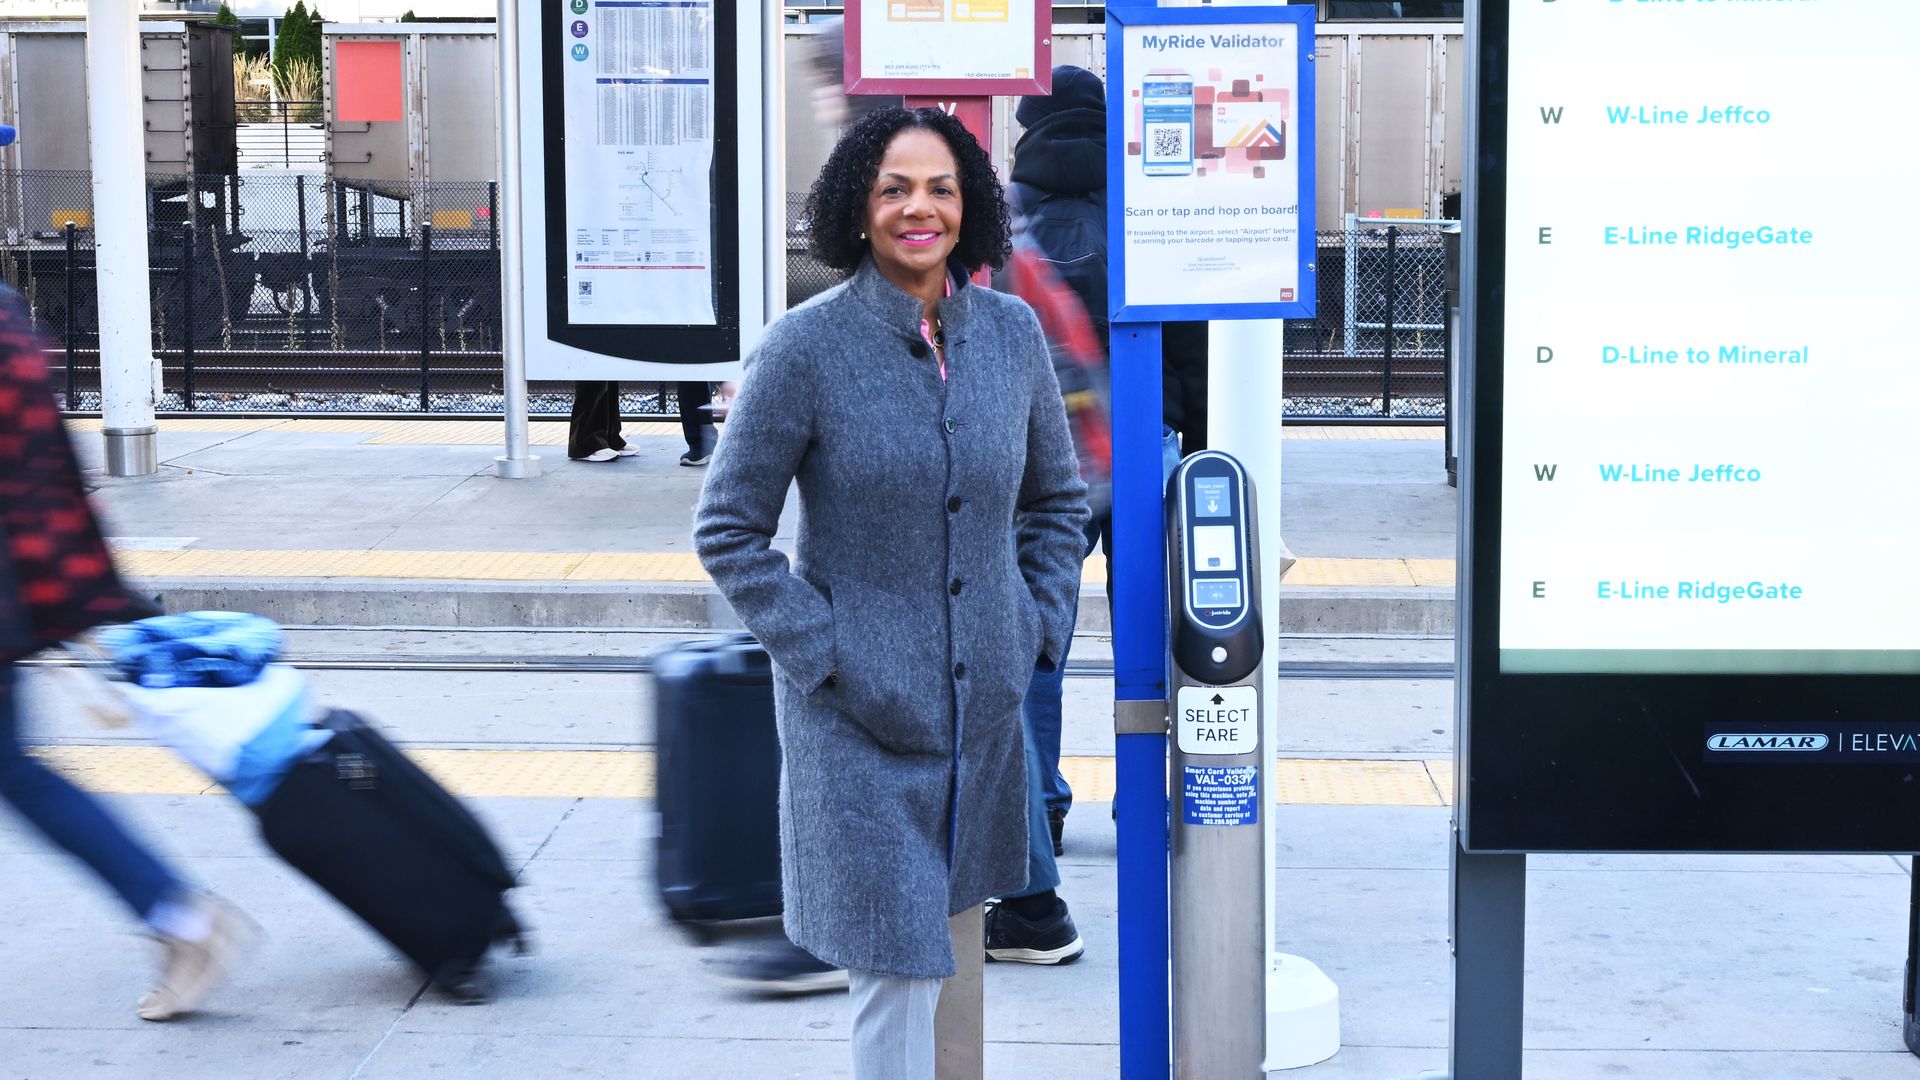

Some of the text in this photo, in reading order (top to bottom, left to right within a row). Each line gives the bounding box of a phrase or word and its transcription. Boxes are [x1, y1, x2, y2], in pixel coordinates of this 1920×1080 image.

[575, 0, 583, 8] D
[576, 23, 583, 32] E
[1142, 34, 1285, 52] MyRide Validator
[574, 46, 585, 55] W
[1540, 105, 1771, 125] W W-Line Jeffco
[1125, 205, 1298, 218] Scan or tap and hop on board!
[1134, 229, 1165, 237] traveling
[1189, 229, 1215, 237] airport,
[1538, 225, 1813, 250] E E-Line RidgeGate
[1133, 237, 1166, 245] scanning
[1225, 236, 1253, 244] tapping
[1536, 345, 1809, 364] D D-Line to Mineral
[1533, 463, 1761, 483] W W-Line Jeffco
[1532, 579, 1803, 605] E E-Line RidgeGate
[1185, 708, 1250, 723] SELECT
[1196, 728, 1239, 742] FARE
[1718, 733, 1920, 751] LAMAR ELEVA
[1185, 767, 1206, 775] Smart
[1185, 791, 1199, 799] using
